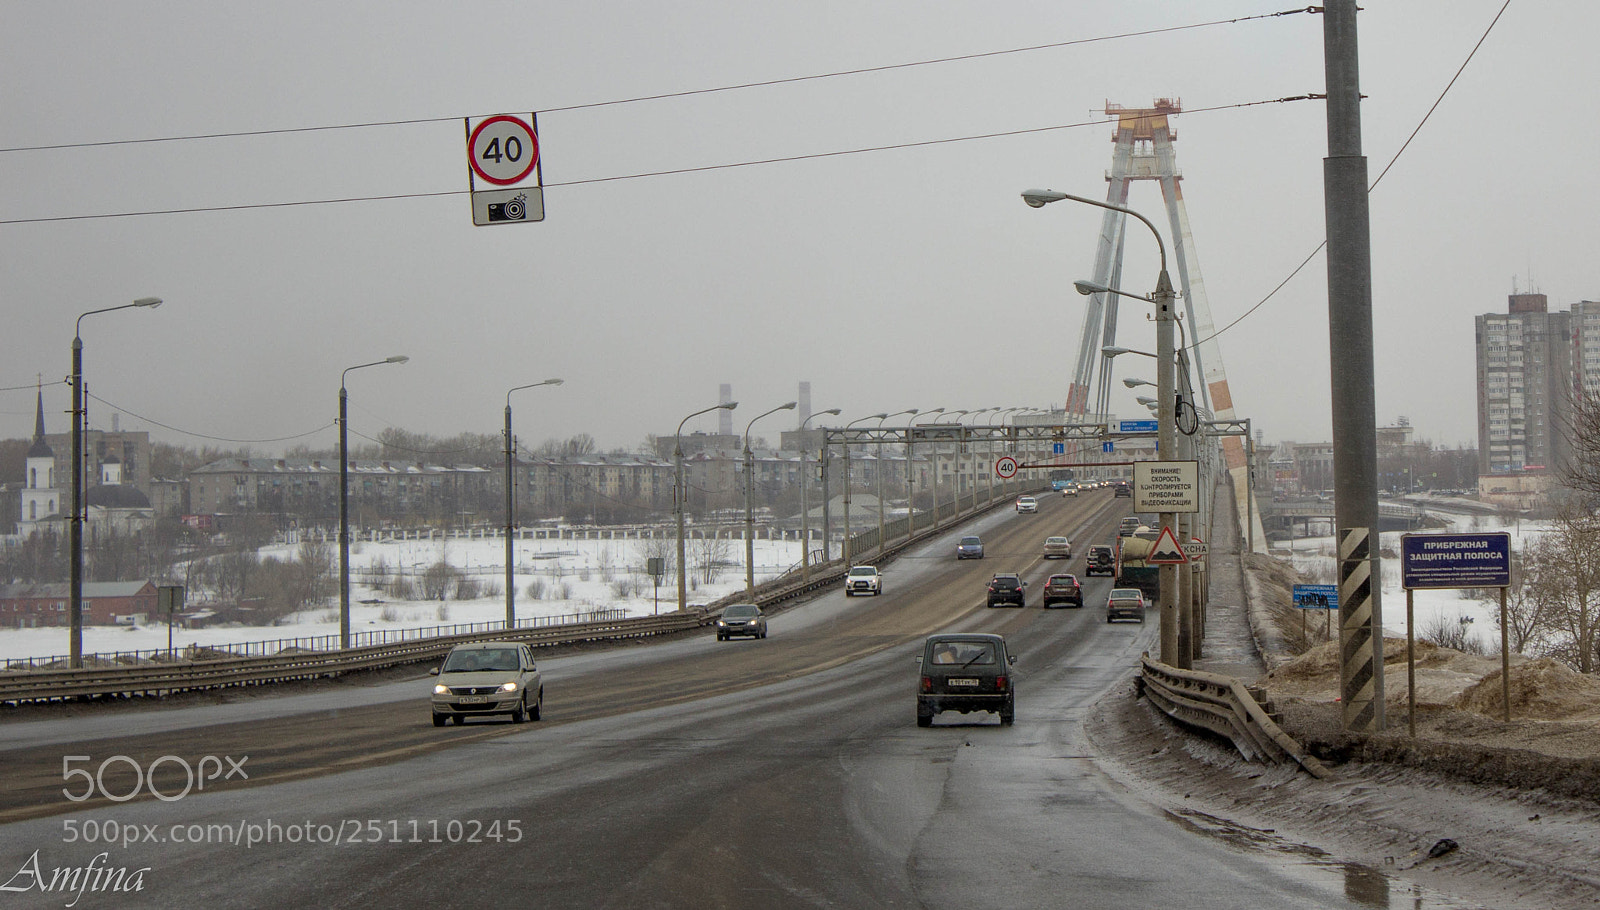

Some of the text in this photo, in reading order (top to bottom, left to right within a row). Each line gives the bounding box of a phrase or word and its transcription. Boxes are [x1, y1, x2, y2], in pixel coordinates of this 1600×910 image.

[482, 136, 523, 164] 40
[1001, 463, 1013, 472] 40
[1181, 545, 1207, 553] КСНА
[1423, 541, 1488, 550] ПРИБРЕЖНАЯ
[1409, 552, 1503, 562] ЗАЩИТНАЯ ПОЛОСА
